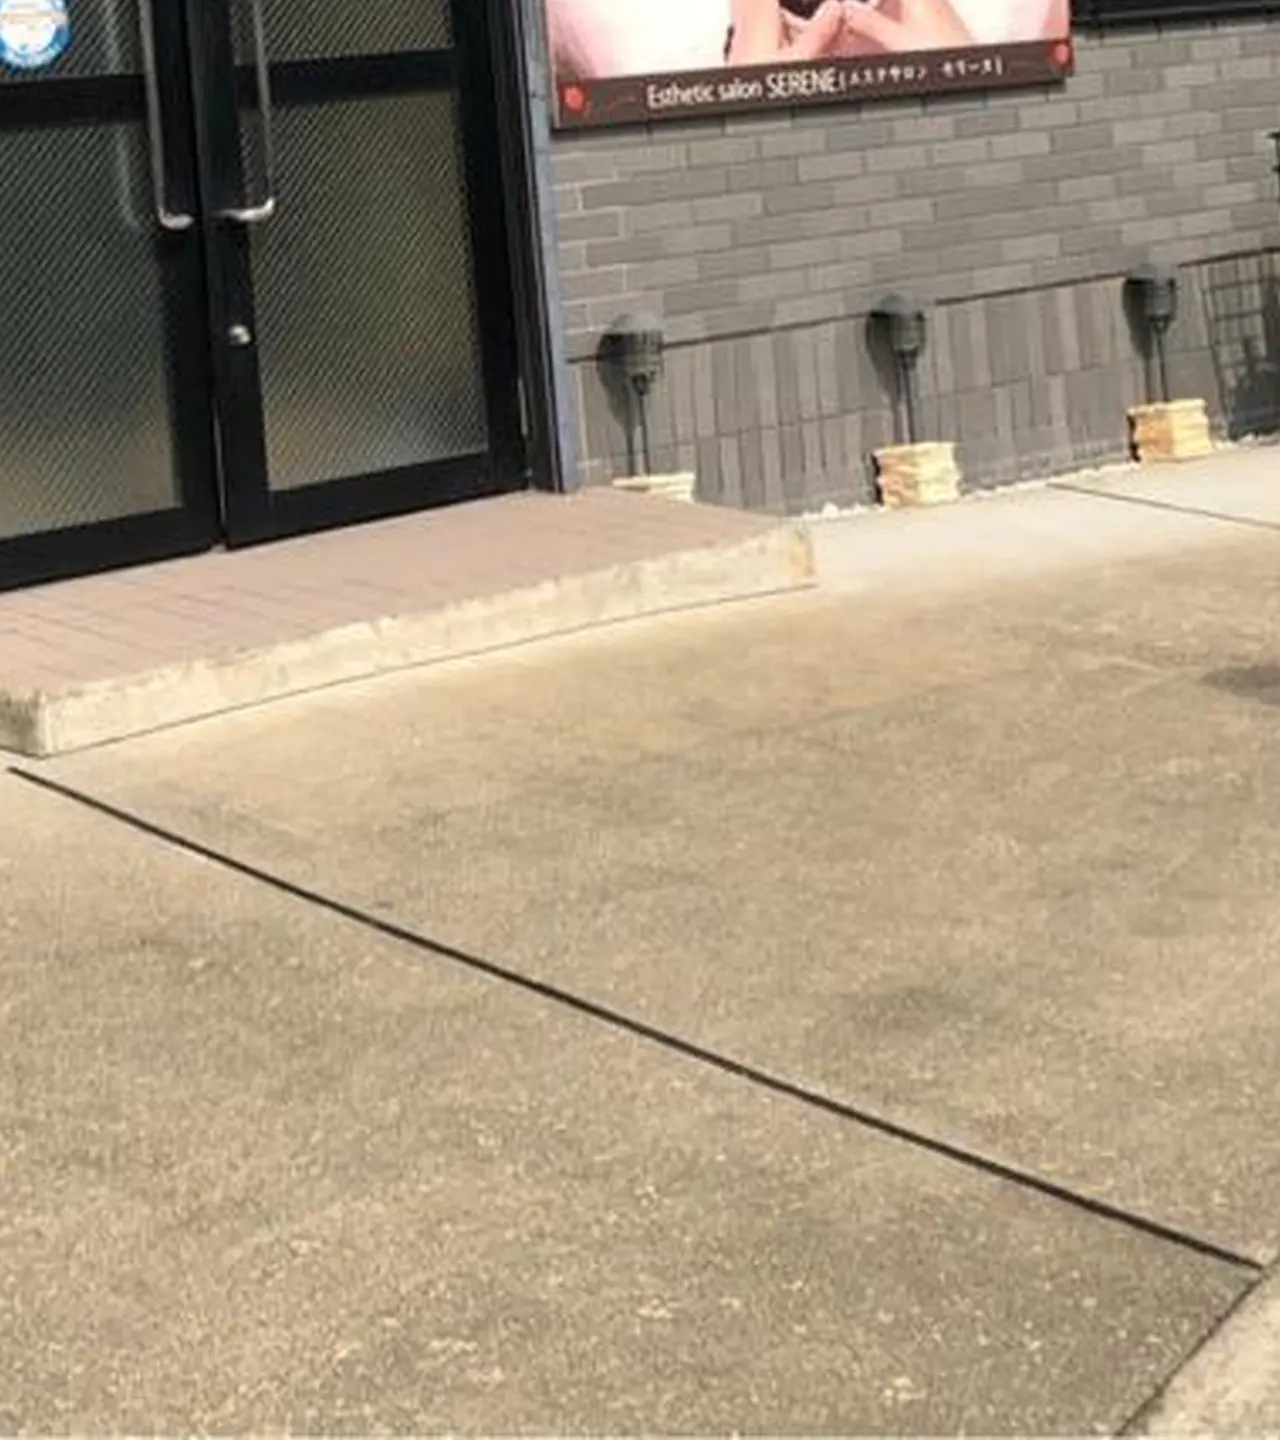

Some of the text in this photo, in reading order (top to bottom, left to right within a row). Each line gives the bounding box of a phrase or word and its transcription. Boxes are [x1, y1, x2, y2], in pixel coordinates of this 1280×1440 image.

[646, 79, 714, 110] Esthetic
[718, 76, 763, 102] salon
[766, 67, 838, 99] SERENE
